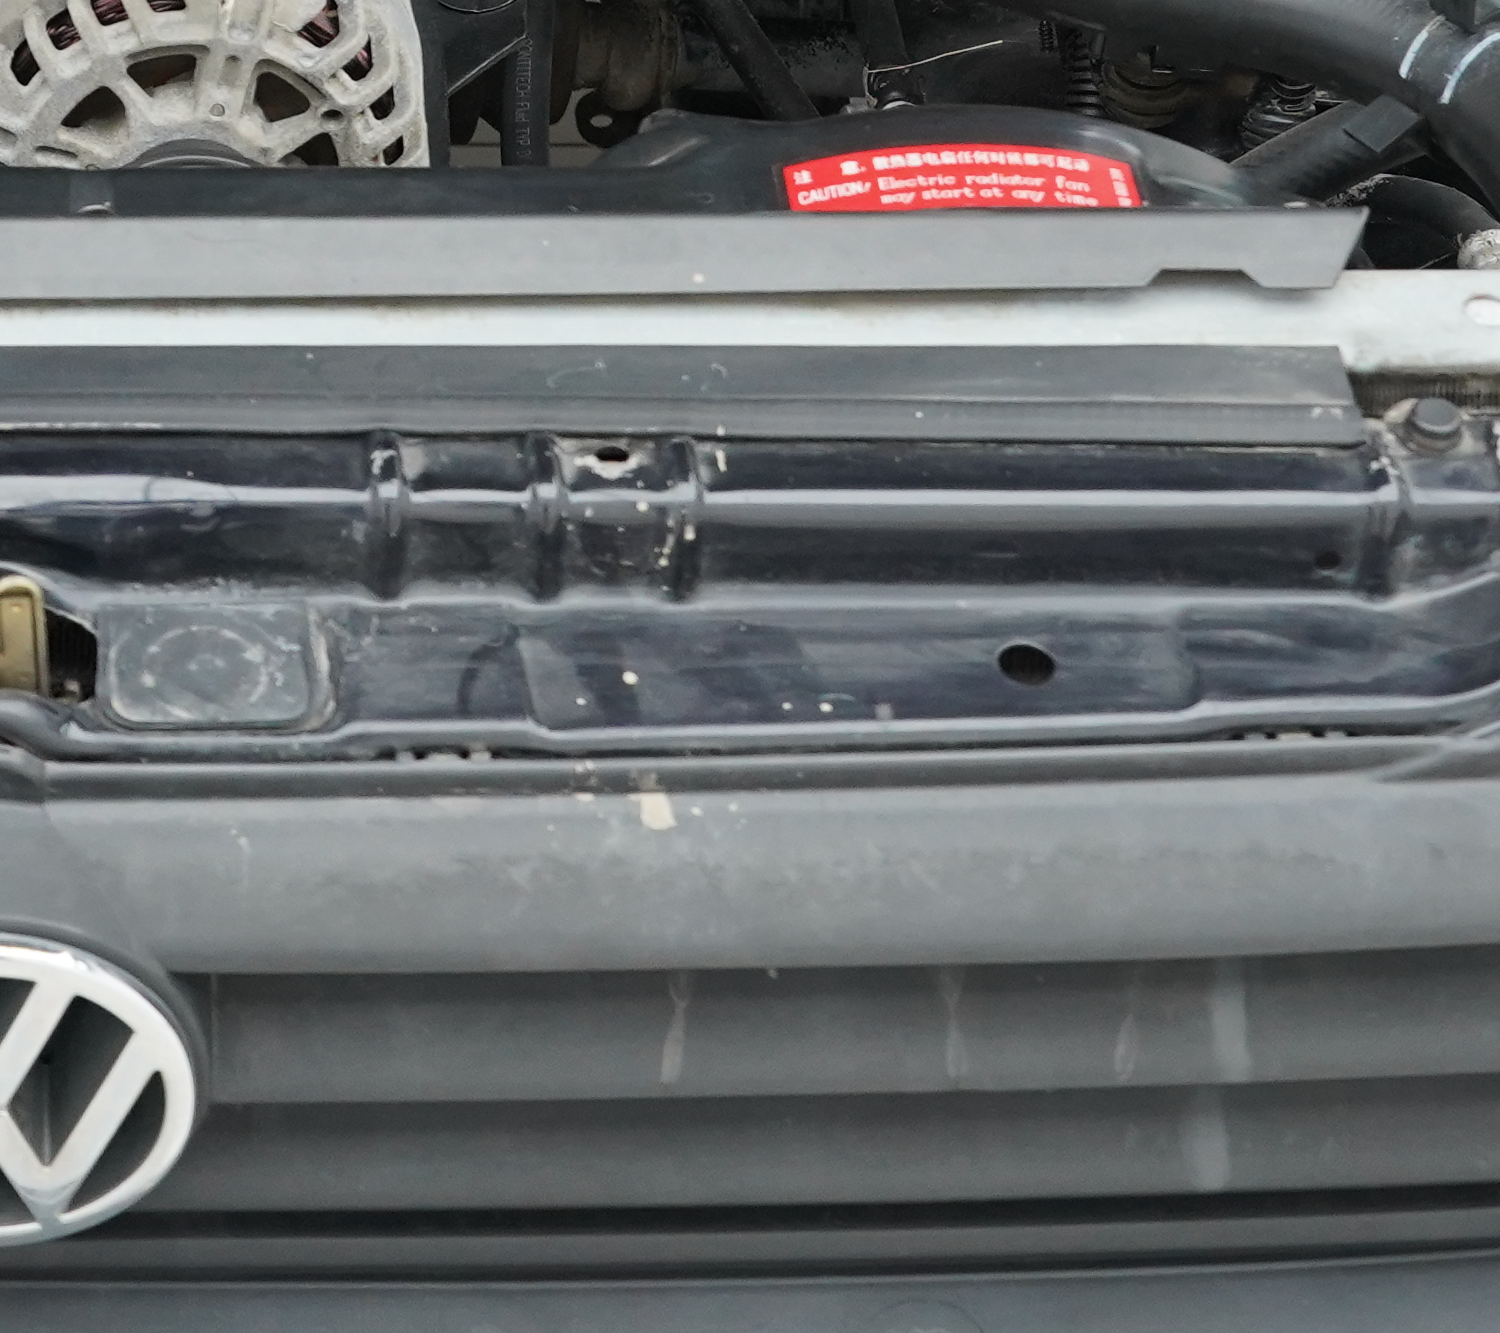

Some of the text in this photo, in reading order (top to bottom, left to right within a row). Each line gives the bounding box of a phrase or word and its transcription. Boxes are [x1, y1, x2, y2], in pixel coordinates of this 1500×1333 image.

[877, 173, 957, 192] Electric
[964, 172, 1046, 187] radiator
[1054, 174, 1091, 193] fan
[879, 186, 1100, 207] may start at any time
